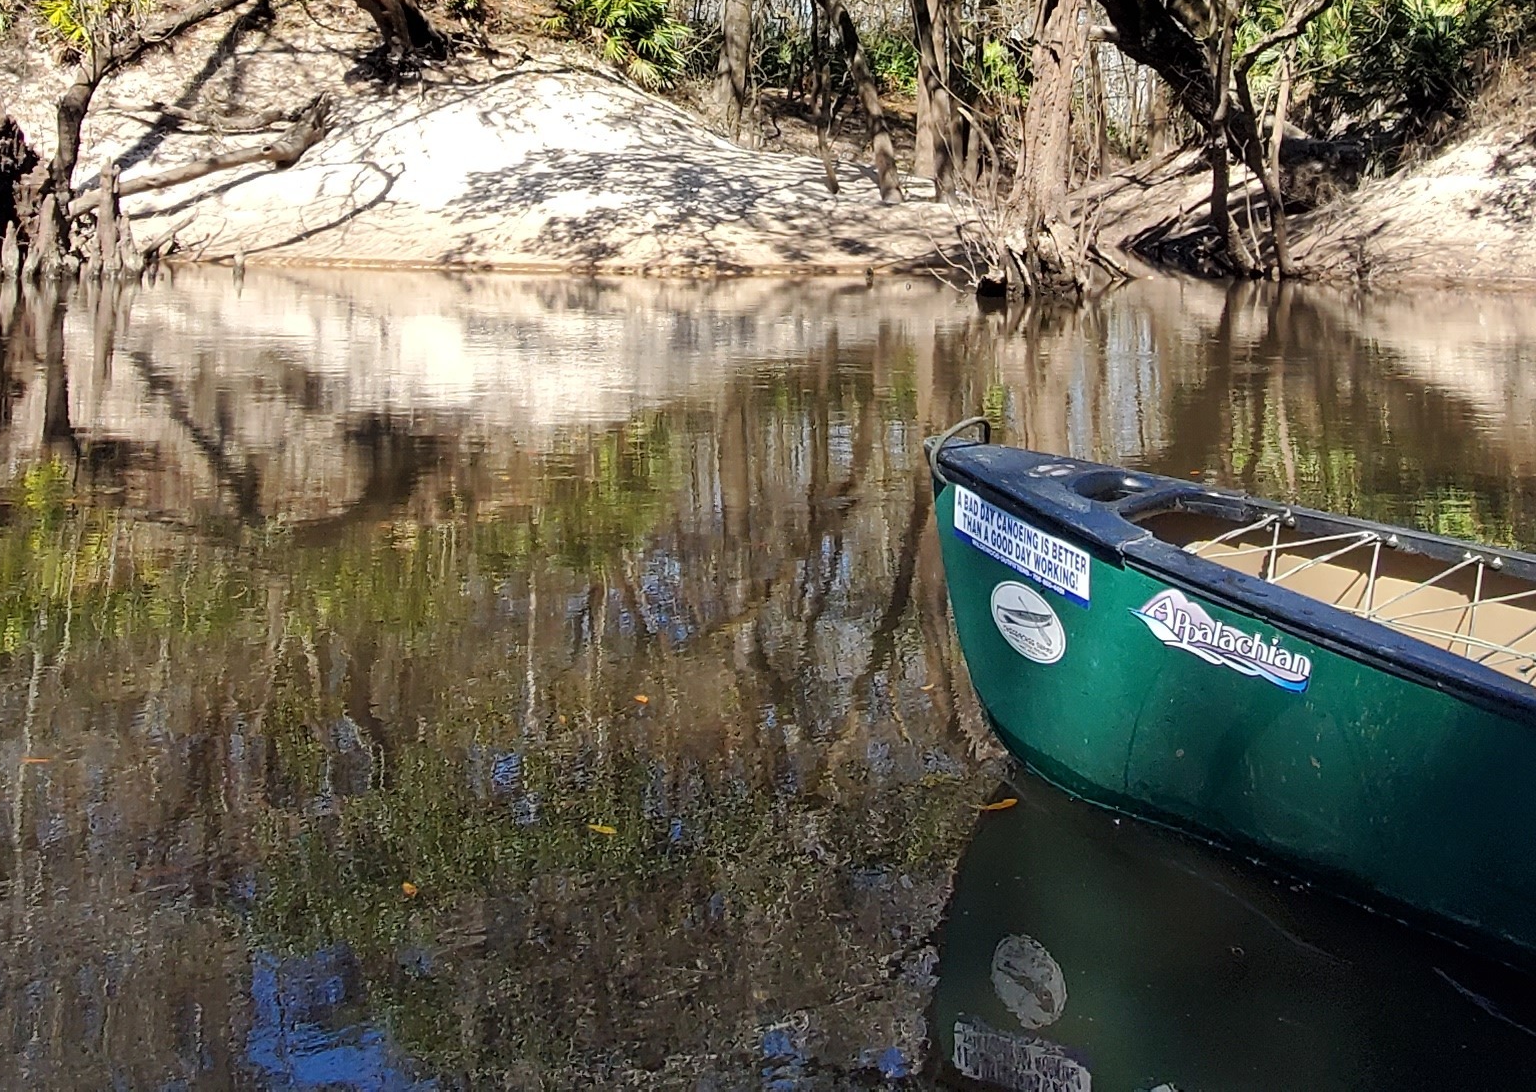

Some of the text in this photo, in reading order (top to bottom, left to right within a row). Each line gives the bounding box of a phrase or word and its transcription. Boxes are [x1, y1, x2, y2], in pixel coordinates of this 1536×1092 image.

[957, 491, 1086, 575] A BAD DAY CANOEING IS BETTER
[963, 512, 982, 538] THAN
[984, 524, 989, 542] A
[991, 529, 1013, 556] GOOD
[1015, 543, 1031, 566] DAY
[1034, 551, 1078, 591] WORKING!
